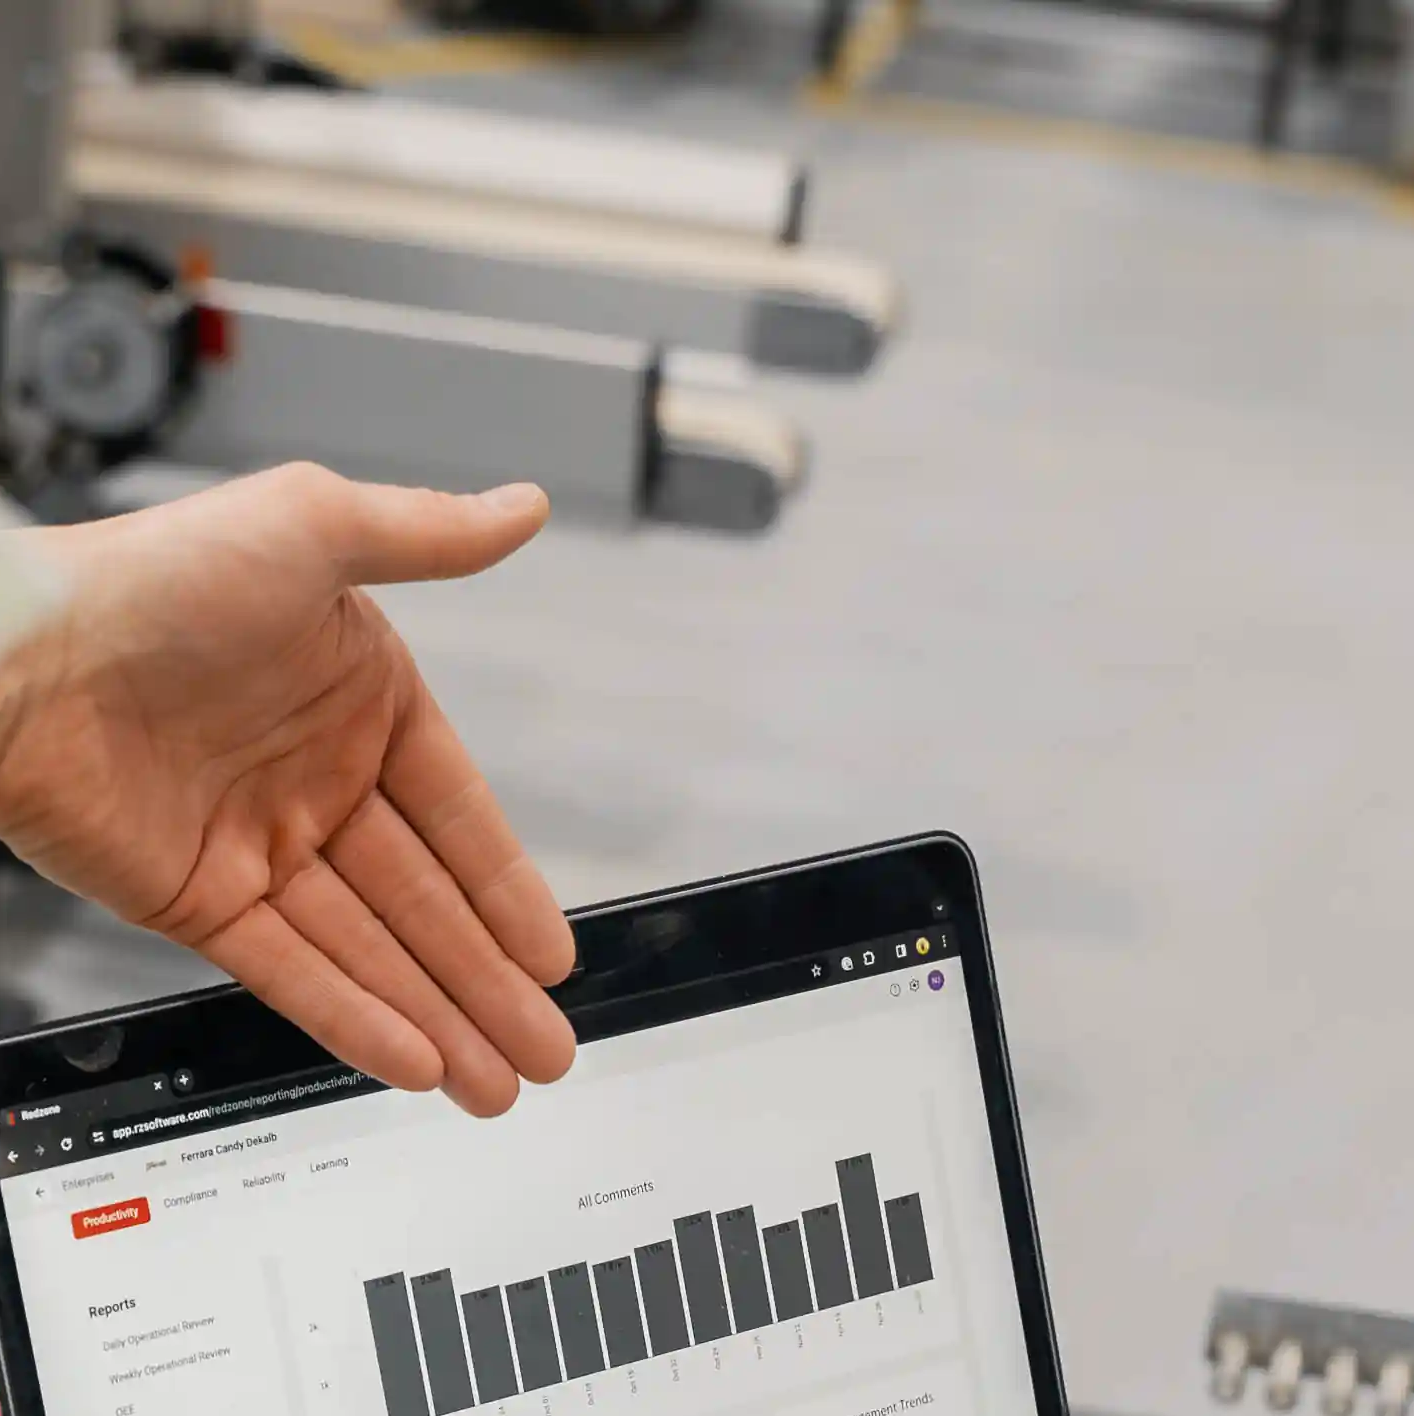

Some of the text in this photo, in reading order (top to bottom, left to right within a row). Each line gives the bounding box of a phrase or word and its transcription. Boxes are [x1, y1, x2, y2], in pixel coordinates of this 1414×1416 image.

[21, 1103, 61, 1122] Redzone
[181, 1132, 278, 1164] Ferrara Candy Dekalb
[309, 1155, 350, 1175] Learning
[61, 1169, 115, 1193] Enterprises
[242, 1169, 287, 1190] Reliability
[163, 1187, 218, 1210] Compliance
[578, 1179, 655, 1211] All Comments
[83, 1205, 139, 1230] Productivity
[88, 1298, 137, 1319] Reports
[102, 1315, 215, 1352] Daily Operational Review
[109, 1346, 231, 1385] Weekly Operational Review
[900, 1391, 934, 1411] Trends
